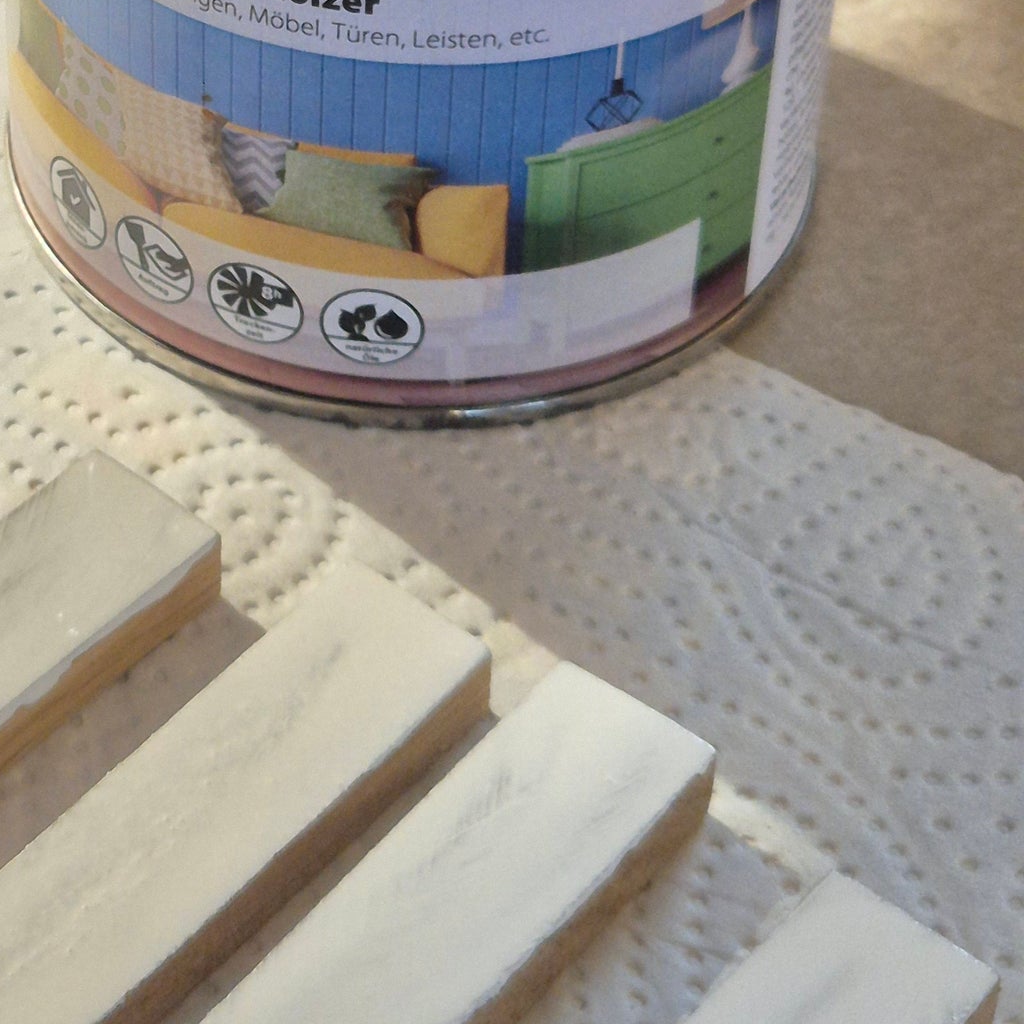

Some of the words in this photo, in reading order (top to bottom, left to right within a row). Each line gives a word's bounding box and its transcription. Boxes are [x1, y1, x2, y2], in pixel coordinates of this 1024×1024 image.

[248, 4, 325, 42] Möbel,
[331, 21, 406, 50] Türen,
[412, 29, 503, 50] Leisten,
[509, 27, 551, 46] etc.
